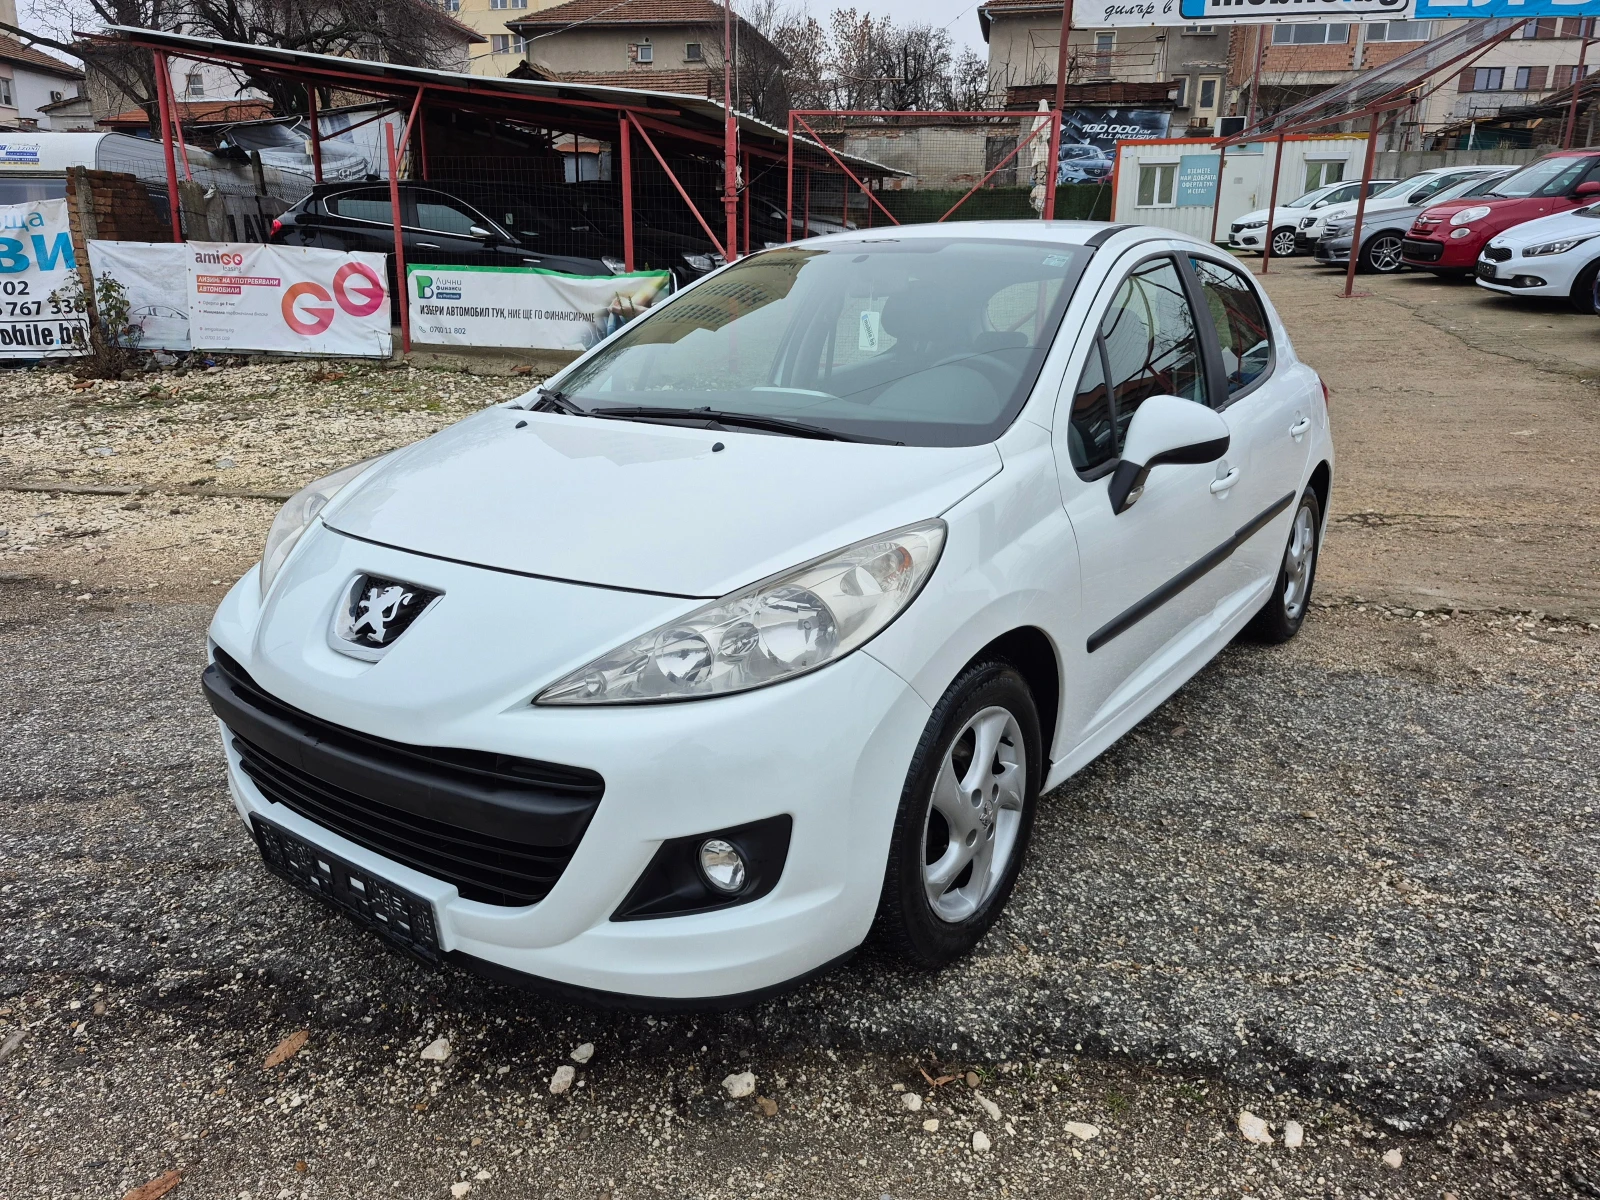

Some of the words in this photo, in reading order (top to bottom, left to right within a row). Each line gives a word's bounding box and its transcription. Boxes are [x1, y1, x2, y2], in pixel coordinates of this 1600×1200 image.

[1104, 2, 1155, 21] дилър
[1081, 124, 1107, 133] 100
[1108, 125, 1140, 134] 000
[0, 212, 45, 232] ща
[222, 265, 242, 273] leasing
[0, 280, 30, 296] 02
[436, 277, 462, 286] Лични
[5, 301, 42, 316] 767
[420, 305, 444, 316] ИЗБЕРИ
[446, 306, 490, 317] АВТОМОБИЛ
[491, 307, 506, 319] ТУК,
[507, 308, 521, 319] НИЕ
[522, 309, 533, 320] ЩЕ
[534, 309, 543, 320] ГО
[543, 310, 595, 323] ФИНАНСИРАМЕ
[429, 326, 444, 334] 0700
[453, 327, 466, 335] 802
